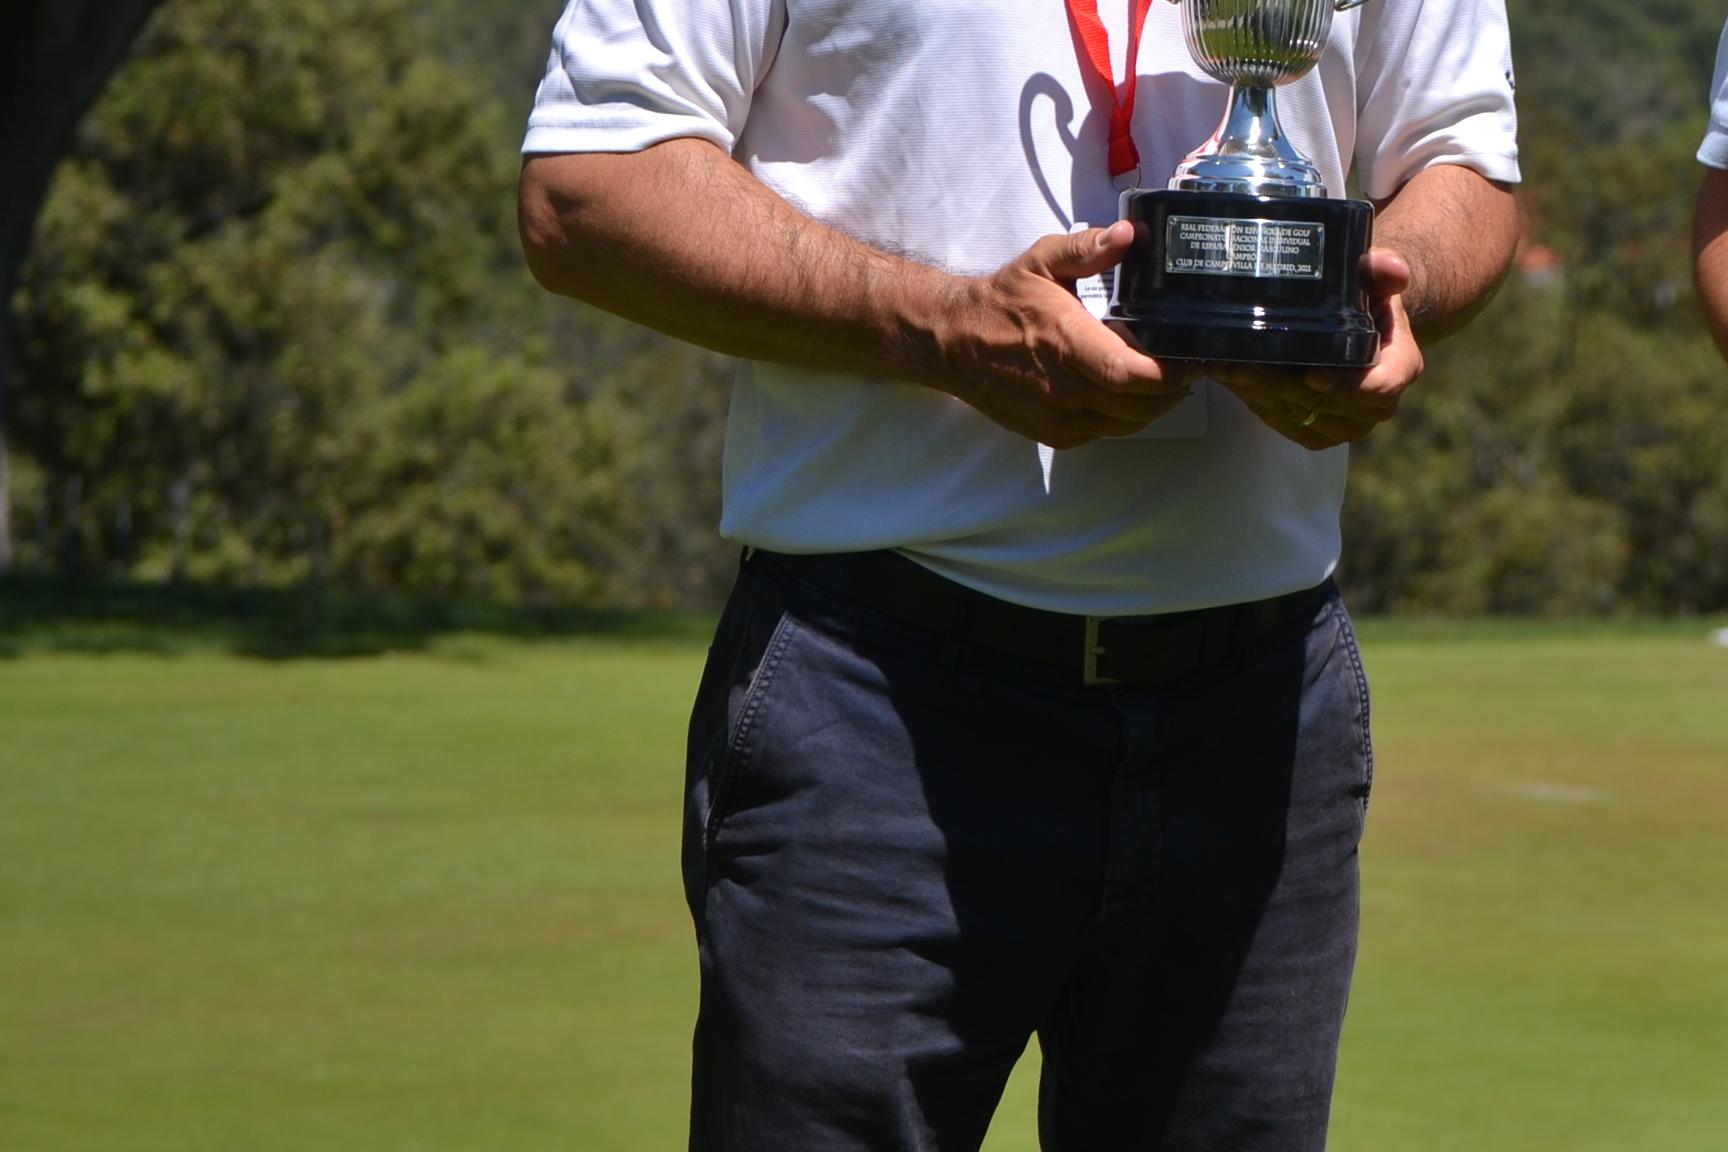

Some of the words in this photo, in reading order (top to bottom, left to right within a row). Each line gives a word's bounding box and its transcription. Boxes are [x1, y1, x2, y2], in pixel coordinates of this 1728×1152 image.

[1180, 223, 1196, 231] REAL
[1197, 223, 1244, 234] FEDERAÓN
[1282, 228, 1291, 236] DE
[1293, 229, 1310, 237] GOLF
[1190, 241, 1200, 249] DE
[1176, 258, 1192, 266] CLUB
[1194, 259, 1203, 267] DE
[1232, 261, 1253, 270] VILLA
